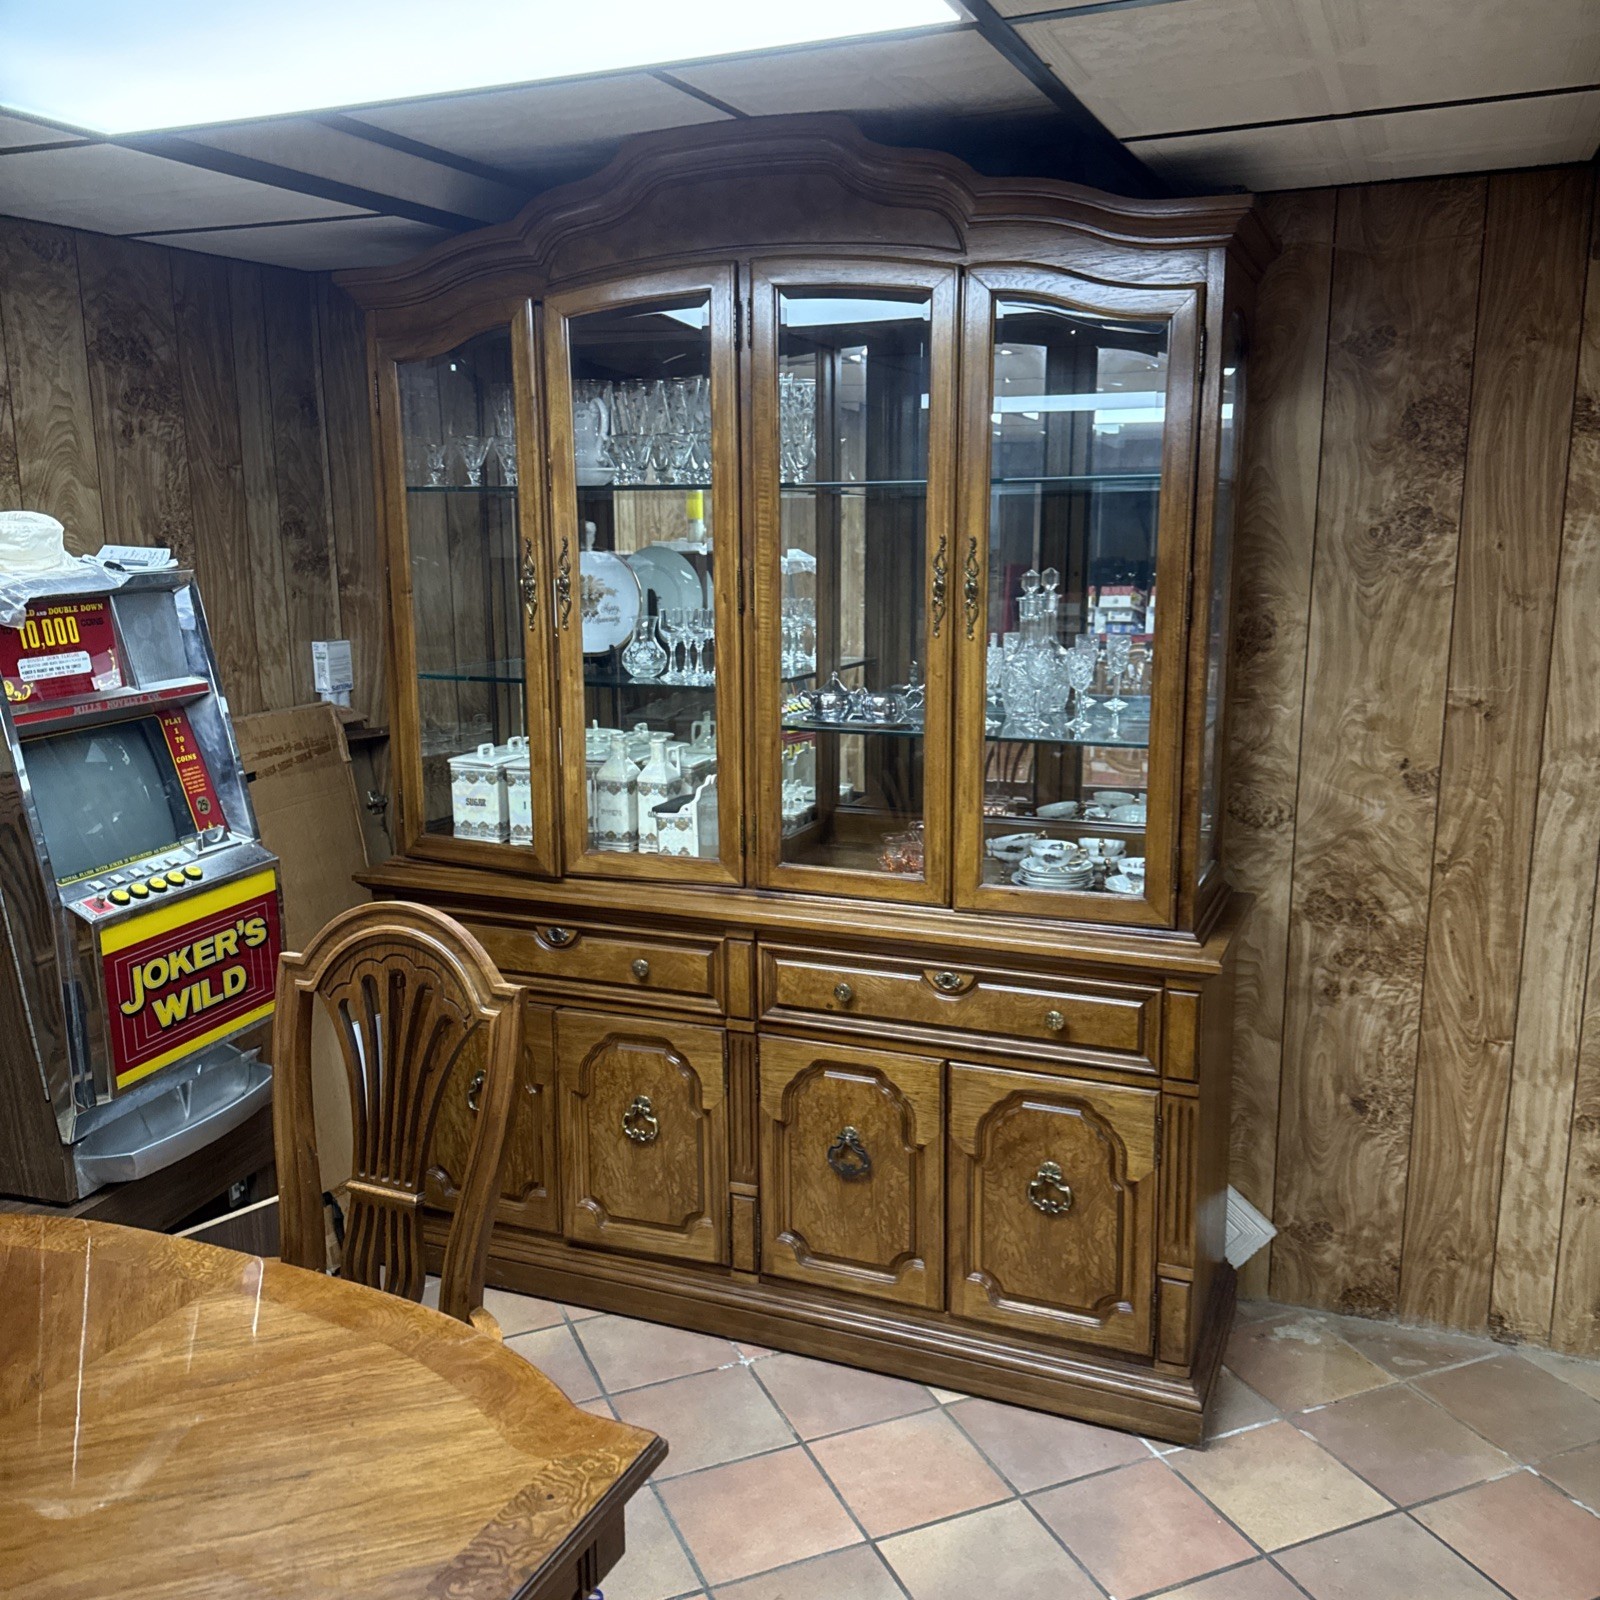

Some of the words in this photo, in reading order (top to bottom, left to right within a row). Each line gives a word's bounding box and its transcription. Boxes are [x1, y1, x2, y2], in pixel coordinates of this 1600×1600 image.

[48, 605, 79, 615] DOUBLE
[80, 603, 104, 612] DOWN
[19, 616, 80, 649] 10,000
[74, 702, 101, 715] MILLS
[106, 695, 143, 709] NOVELTY
[164, 717, 182, 726] PLAY
[175, 735, 185, 744] TO
[180, 745, 185, 753] 5
[176, 753, 197, 764] COINS
[465, 797, 487, 807] SUGAR
[120, 916, 268, 1015] JOKER'S
[152, 965, 248, 1029] WILD
